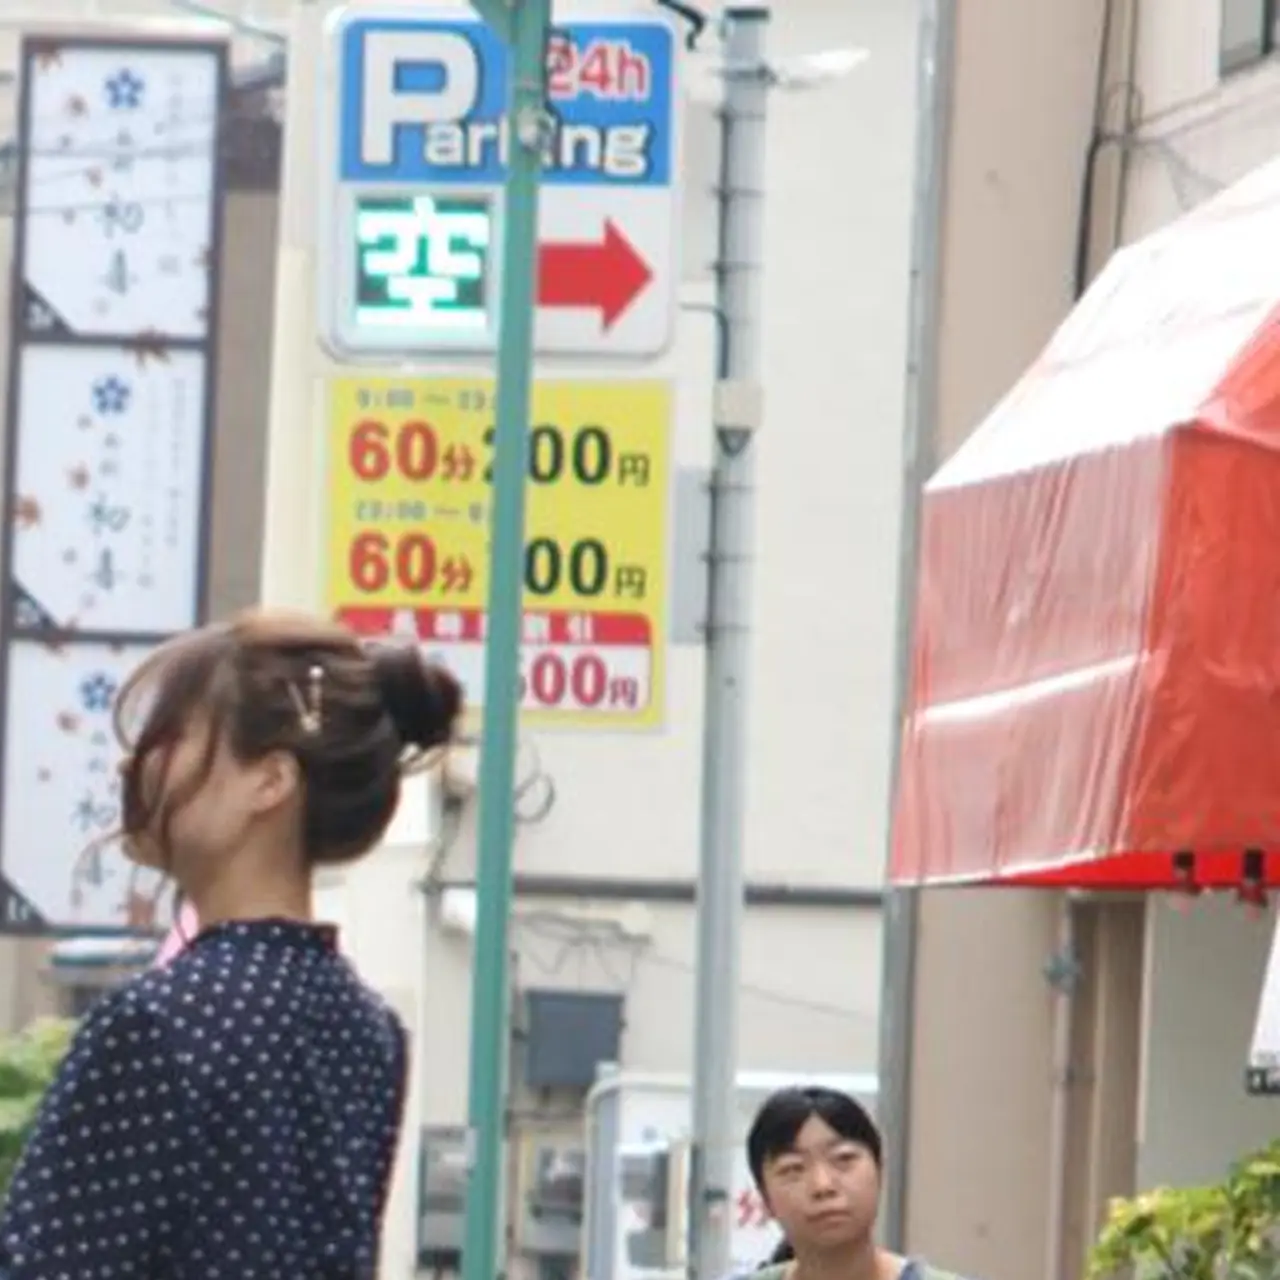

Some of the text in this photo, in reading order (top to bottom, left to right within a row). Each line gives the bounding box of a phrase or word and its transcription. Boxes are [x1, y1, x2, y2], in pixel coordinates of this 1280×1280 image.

[360, 29, 653, 177] Parng
[544, 38, 652, 100] 24h
[354, 195, 492, 326] 空
[349, 418, 476, 485] 60分
[349, 530, 648, 599] 60分 00円
[518, 652, 640, 709] 00円
